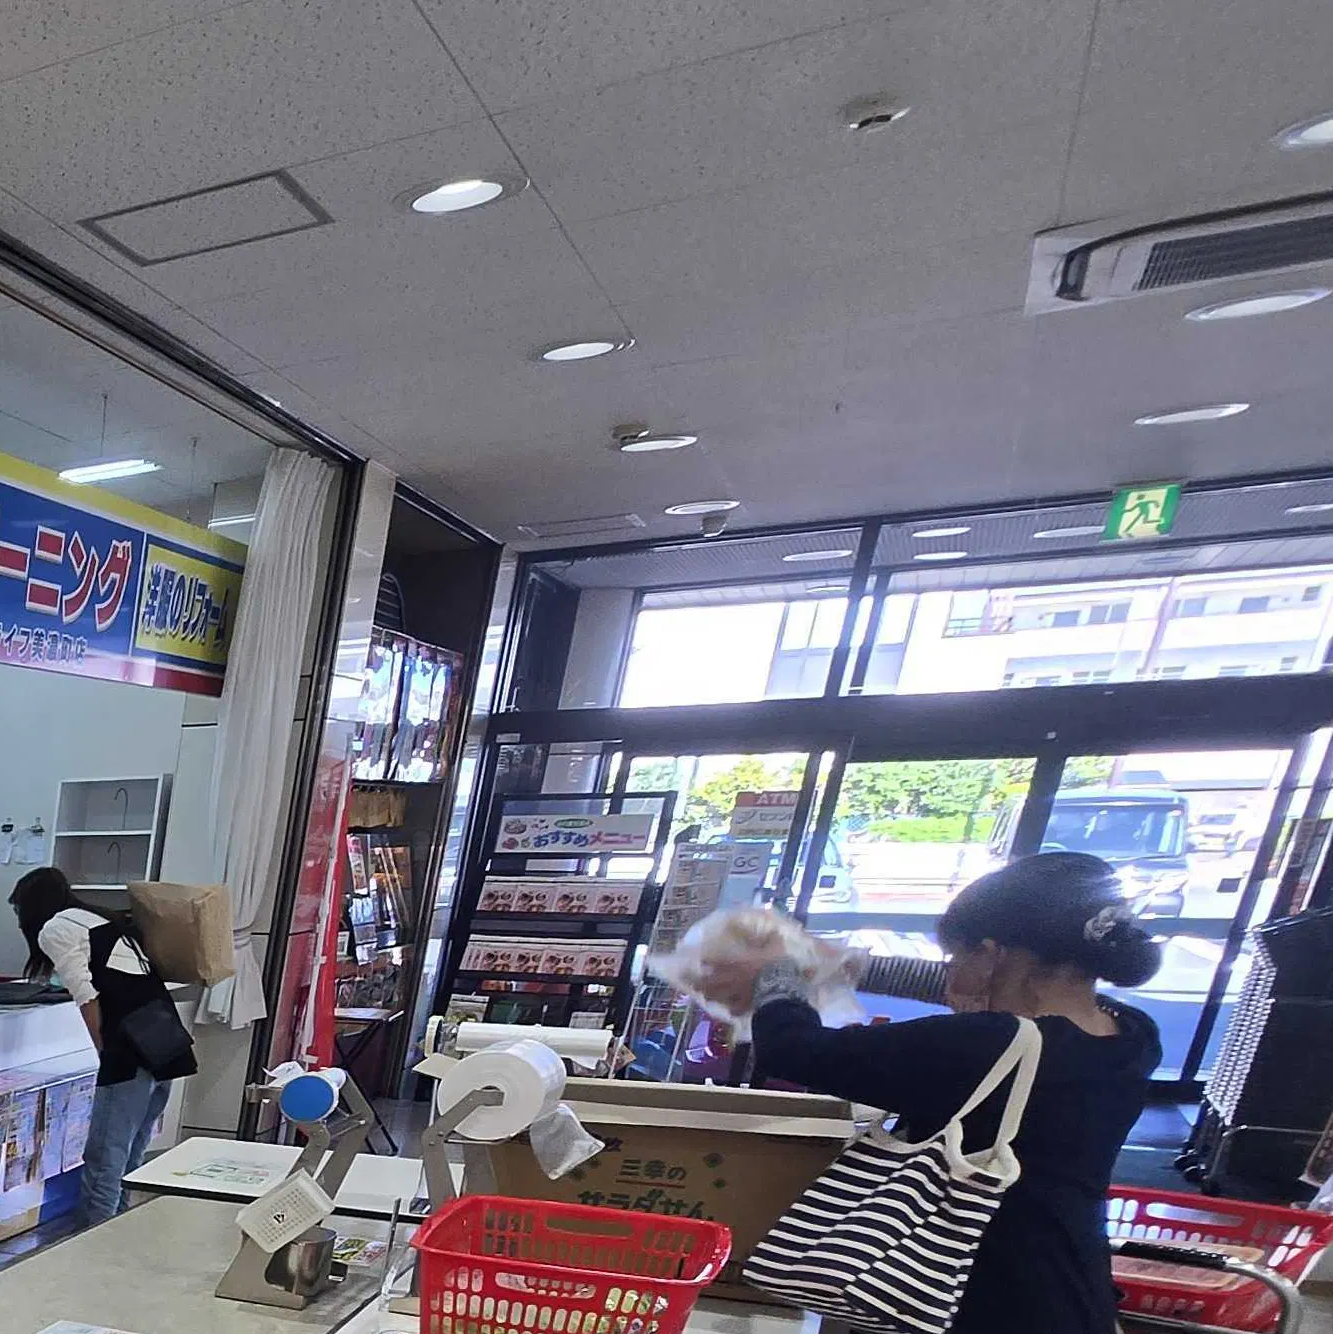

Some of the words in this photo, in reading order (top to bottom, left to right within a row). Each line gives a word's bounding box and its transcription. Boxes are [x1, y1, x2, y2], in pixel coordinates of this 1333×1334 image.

[756, 793, 798, 805] ATM
[533, 829, 646, 848] おすすめメニュー
